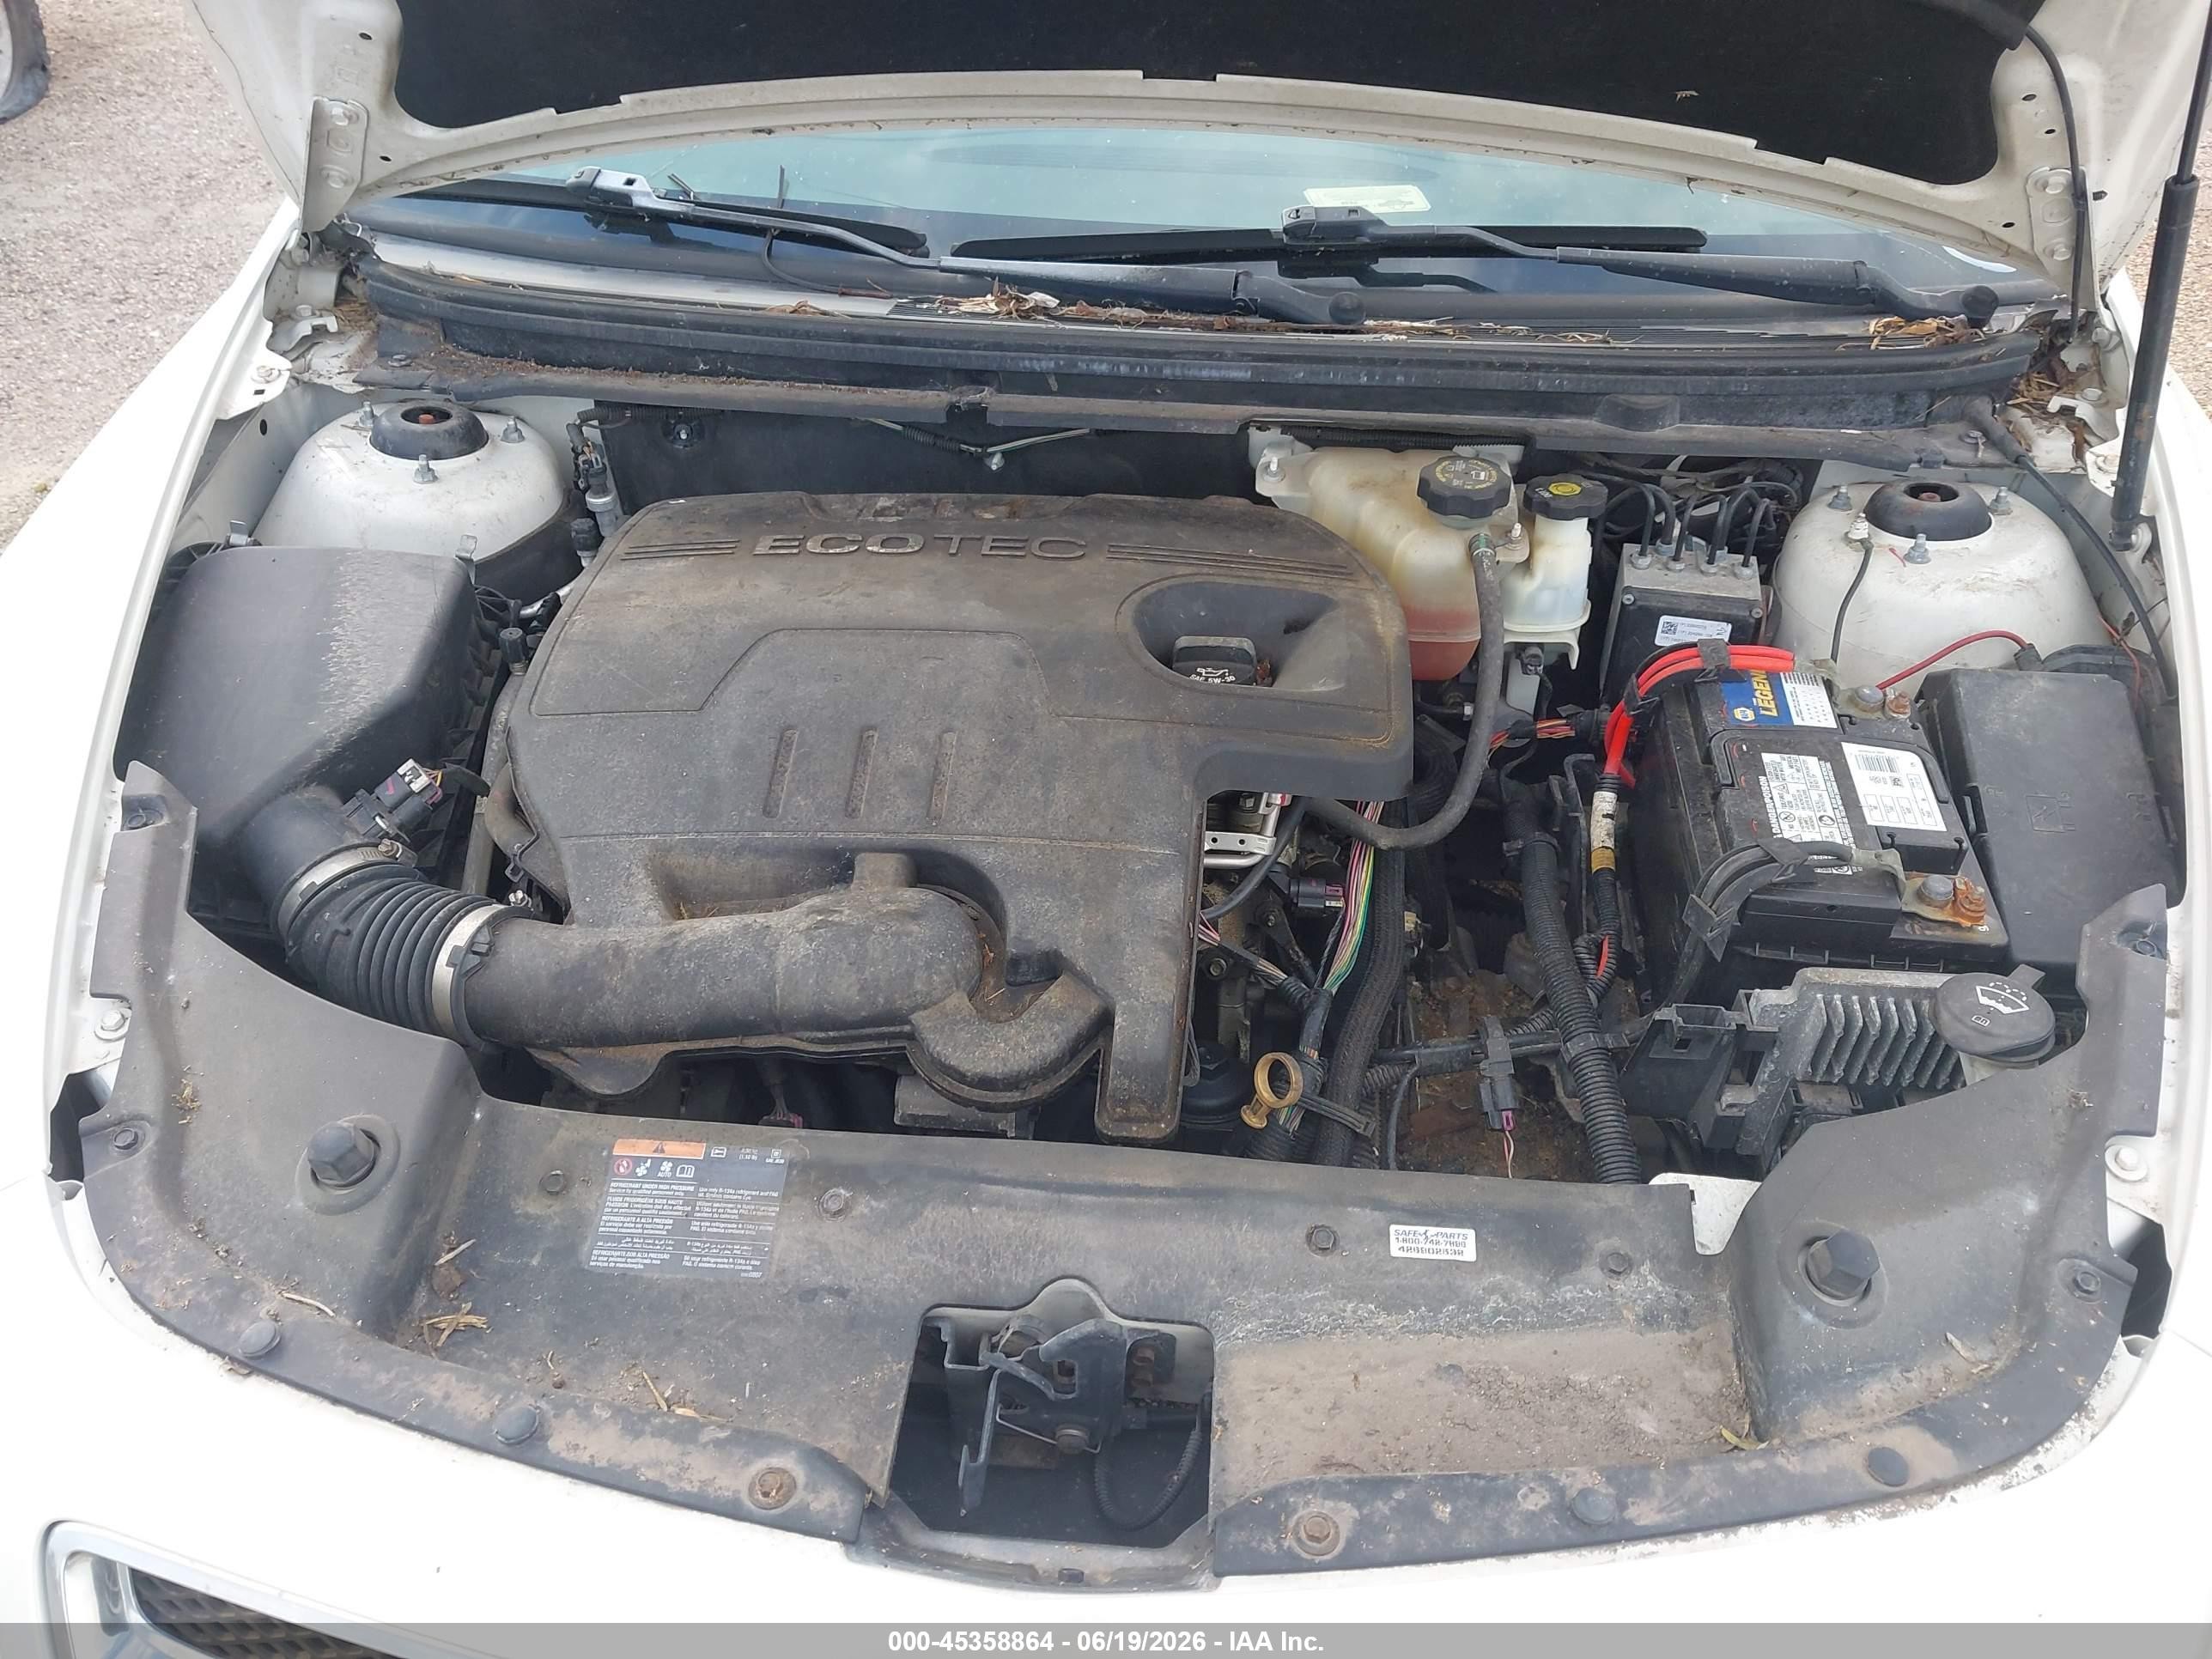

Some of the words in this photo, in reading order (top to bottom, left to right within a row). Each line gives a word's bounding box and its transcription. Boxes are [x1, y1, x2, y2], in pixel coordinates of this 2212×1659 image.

[752, 533, 1085, 561] ECOTEC
[1208, 675, 1236, 684] 5W-30
[1750, 669, 1778, 717] LEGEN
[1759, 776, 1782, 834] DANGER/POISON
